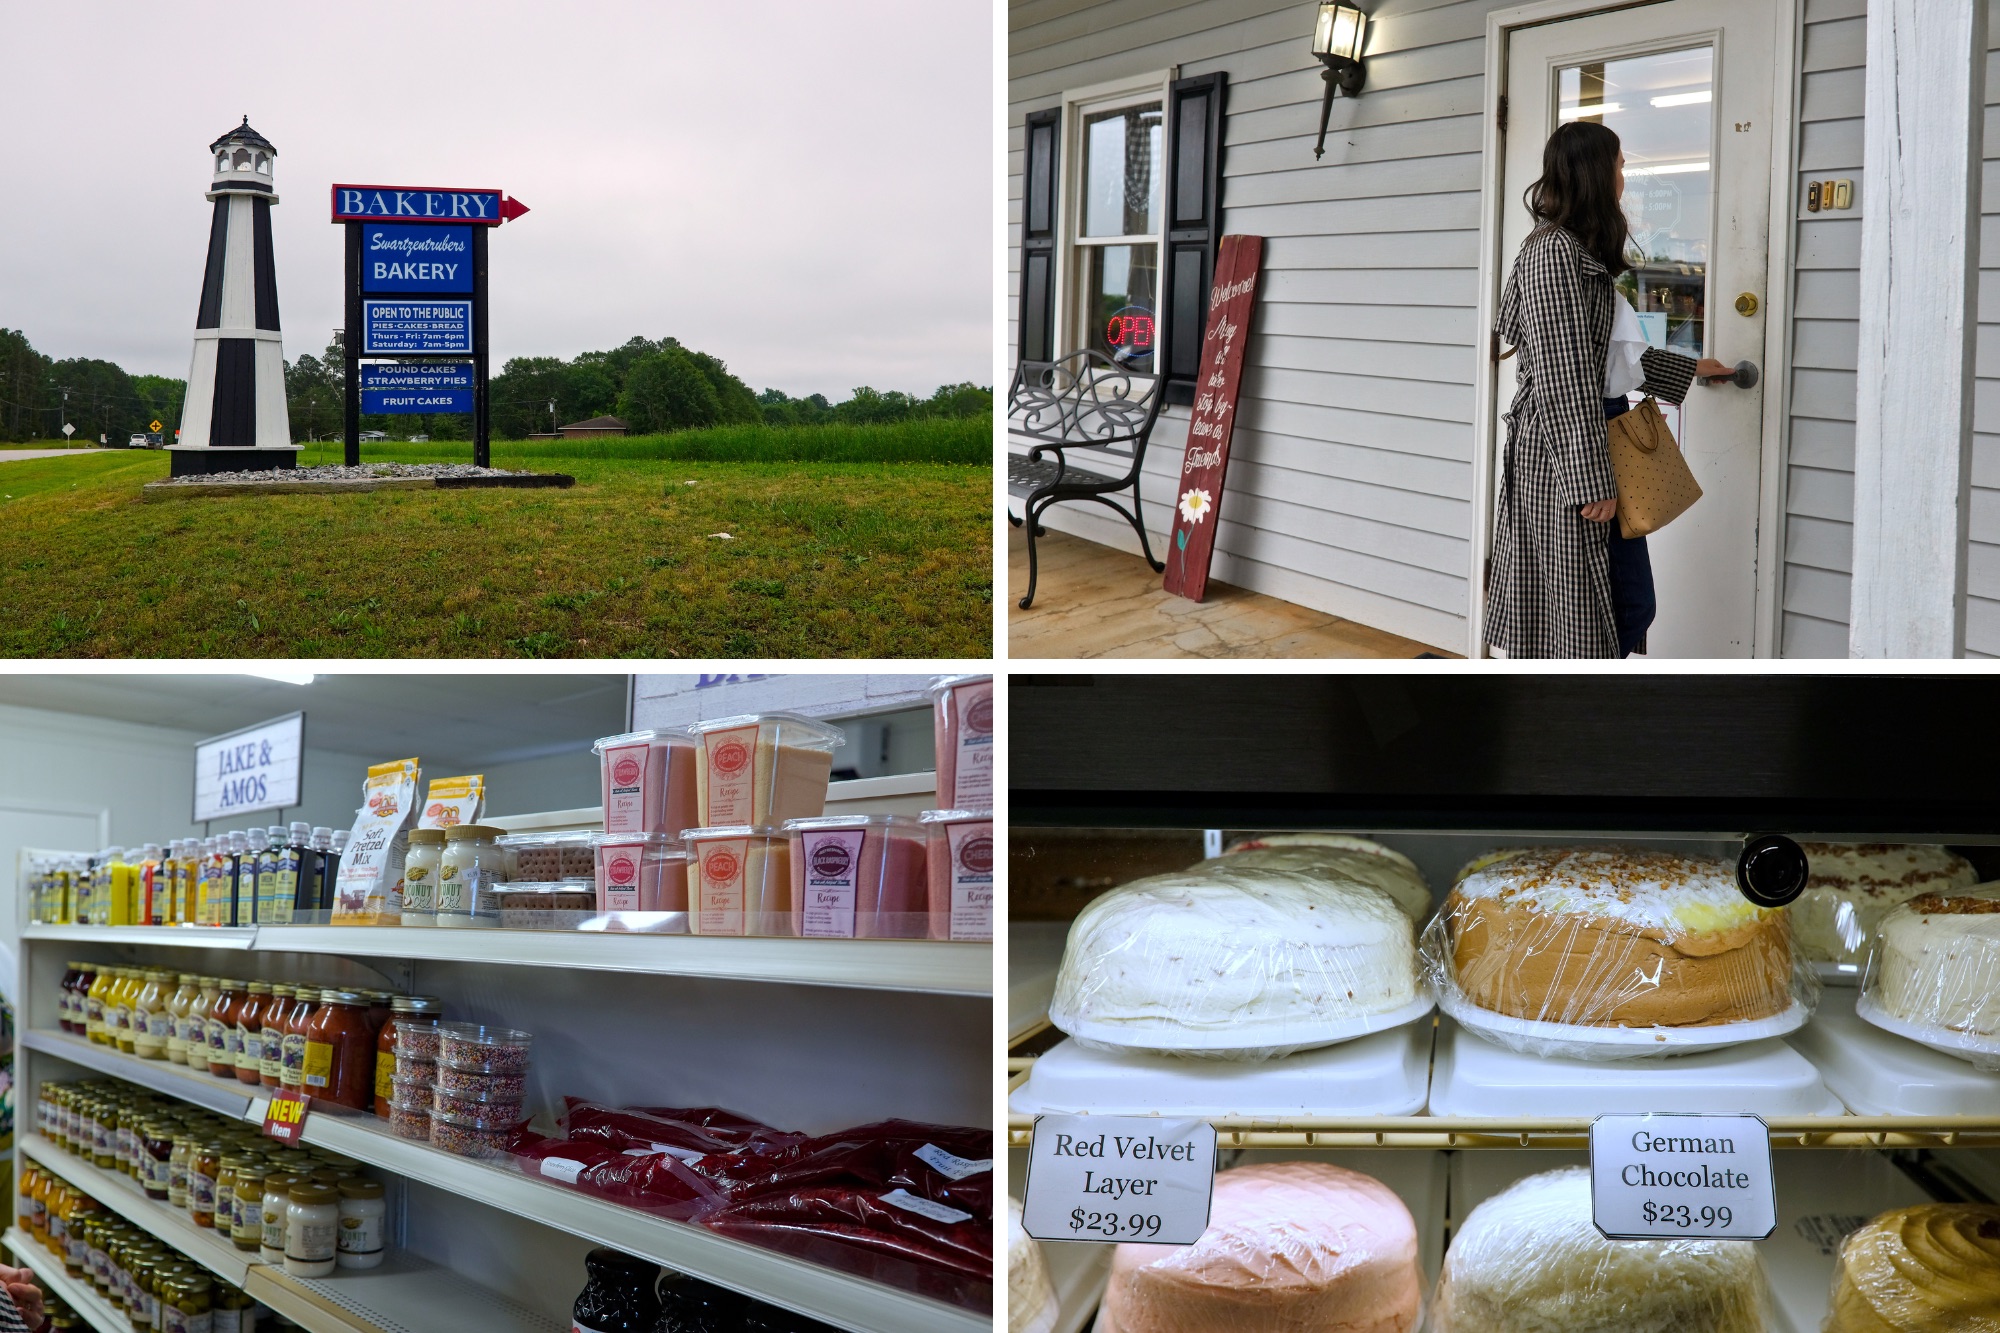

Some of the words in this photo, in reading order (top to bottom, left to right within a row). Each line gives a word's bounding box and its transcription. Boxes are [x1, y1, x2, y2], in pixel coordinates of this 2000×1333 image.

[340, 190, 494, 218] BAKERY
[1649, 202, 1672, 212] 5:00PM
[370, 232, 466, 257] Swartzentrubers
[374, 262, 459, 280] BAKERY
[372, 307, 397, 319] OPEN
[399, 307, 411, 319] TO
[413, 307, 431, 319] THE
[433, 307, 464, 319] PUBLIC
[372, 341, 418, 349] Saturday:
[423, 341, 465, 349] 7am-5pm
[378, 366, 419, 374] POUND
[420, 366, 457, 374] CAKES
[367, 377, 442, 385] STRAWBERRY
[443, 377, 467, 385] PIES
[383, 398, 415, 406] FRUIT
[417, 397, 453, 405] CAKES
[217, 742, 256, 782] JAKE
[259, 738, 272, 767] &
[717, 751, 744, 765] PEACH
[219, 773, 267, 808] AMOS
[363, 827, 384, 840] Soft
[349, 837, 386, 853] Pretzel
[351, 852, 373, 866] Mix
[708, 861, 735, 873] PEACH
[817, 892, 841, 906] Recipe
[267, 1097, 305, 1124] NEW
[1053, 1133, 1105, 1158] Red
[1113, 1136, 1196, 1162] Velvet
[1631, 1131, 1736, 1154] German
[1621, 1163, 1750, 1189] Chocolate
[1082, 1170, 1158, 1201] Layer
[1069, 1205, 1162, 1238] $23.99
[1642, 1198, 1733, 1229] $23.99
